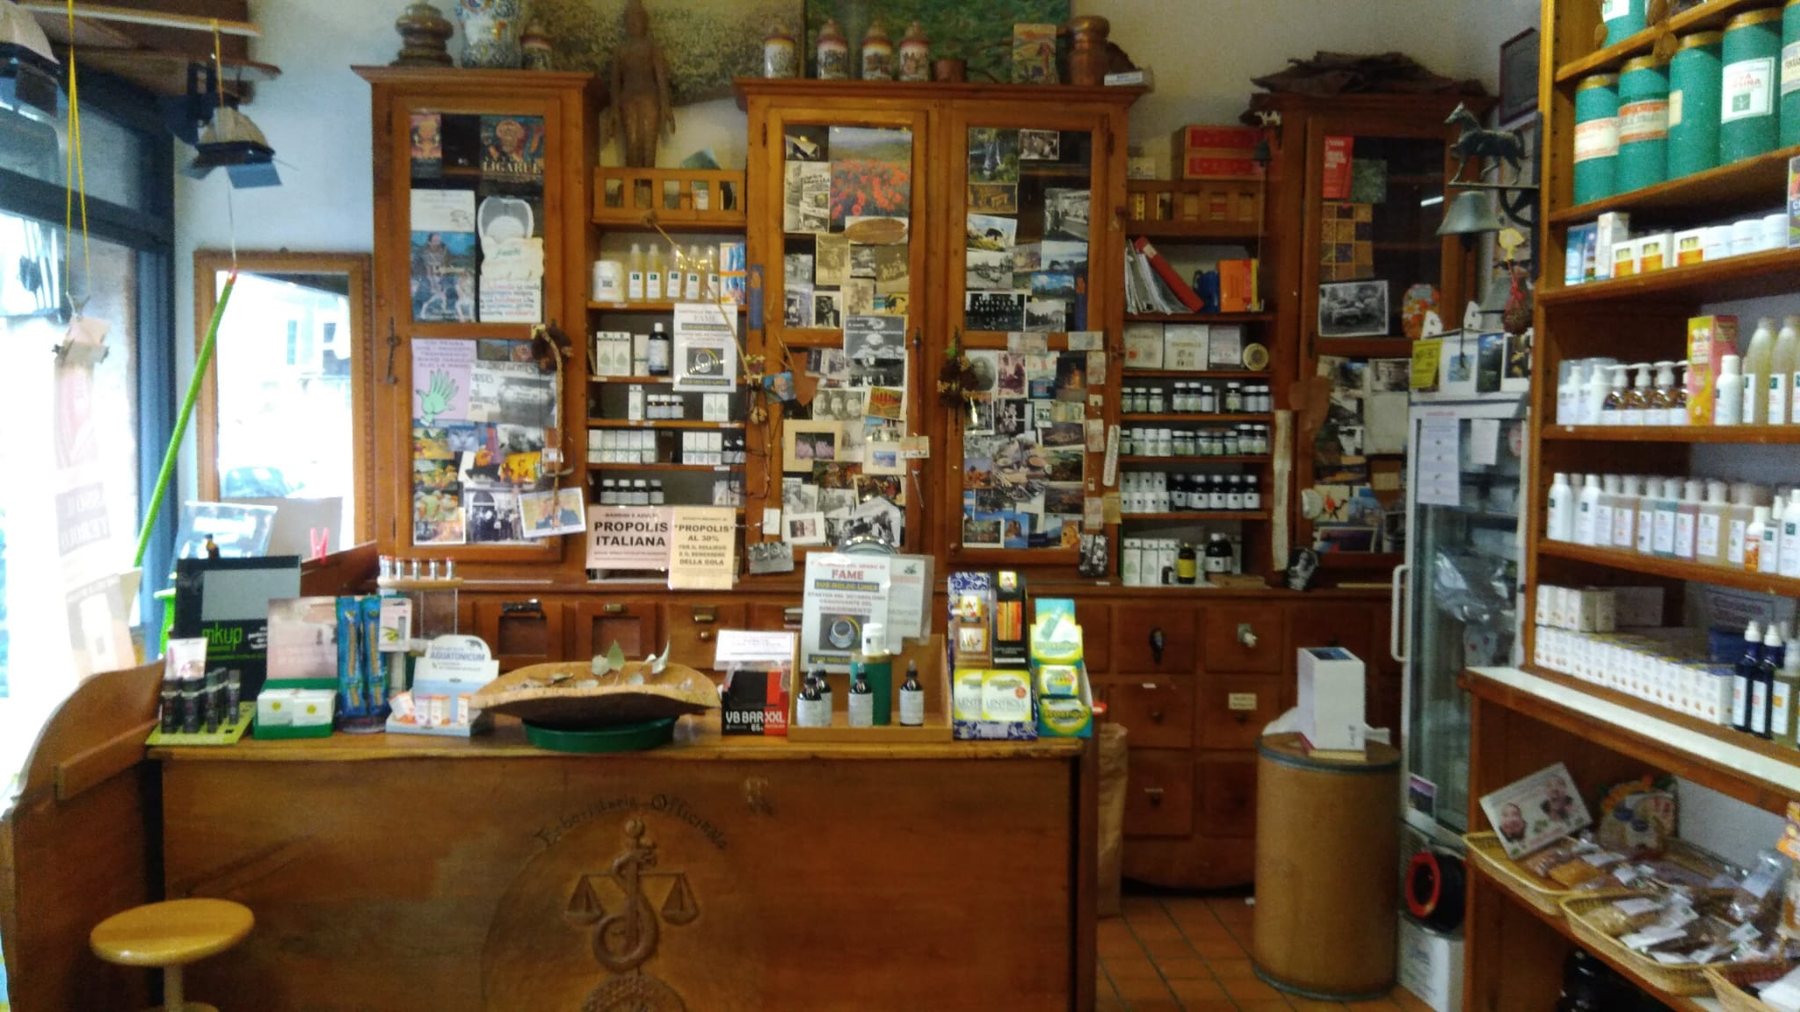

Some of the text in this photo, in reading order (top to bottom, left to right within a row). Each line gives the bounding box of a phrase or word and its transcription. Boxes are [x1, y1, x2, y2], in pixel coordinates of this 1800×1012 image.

[594, 521, 668, 532] PROPOLIS
[596, 536, 666, 547] ITALIANA
[832, 569, 864, 580] FAME
[202, 620, 243, 651] mkup
[725, 711, 785, 724] VB BAR XXL
